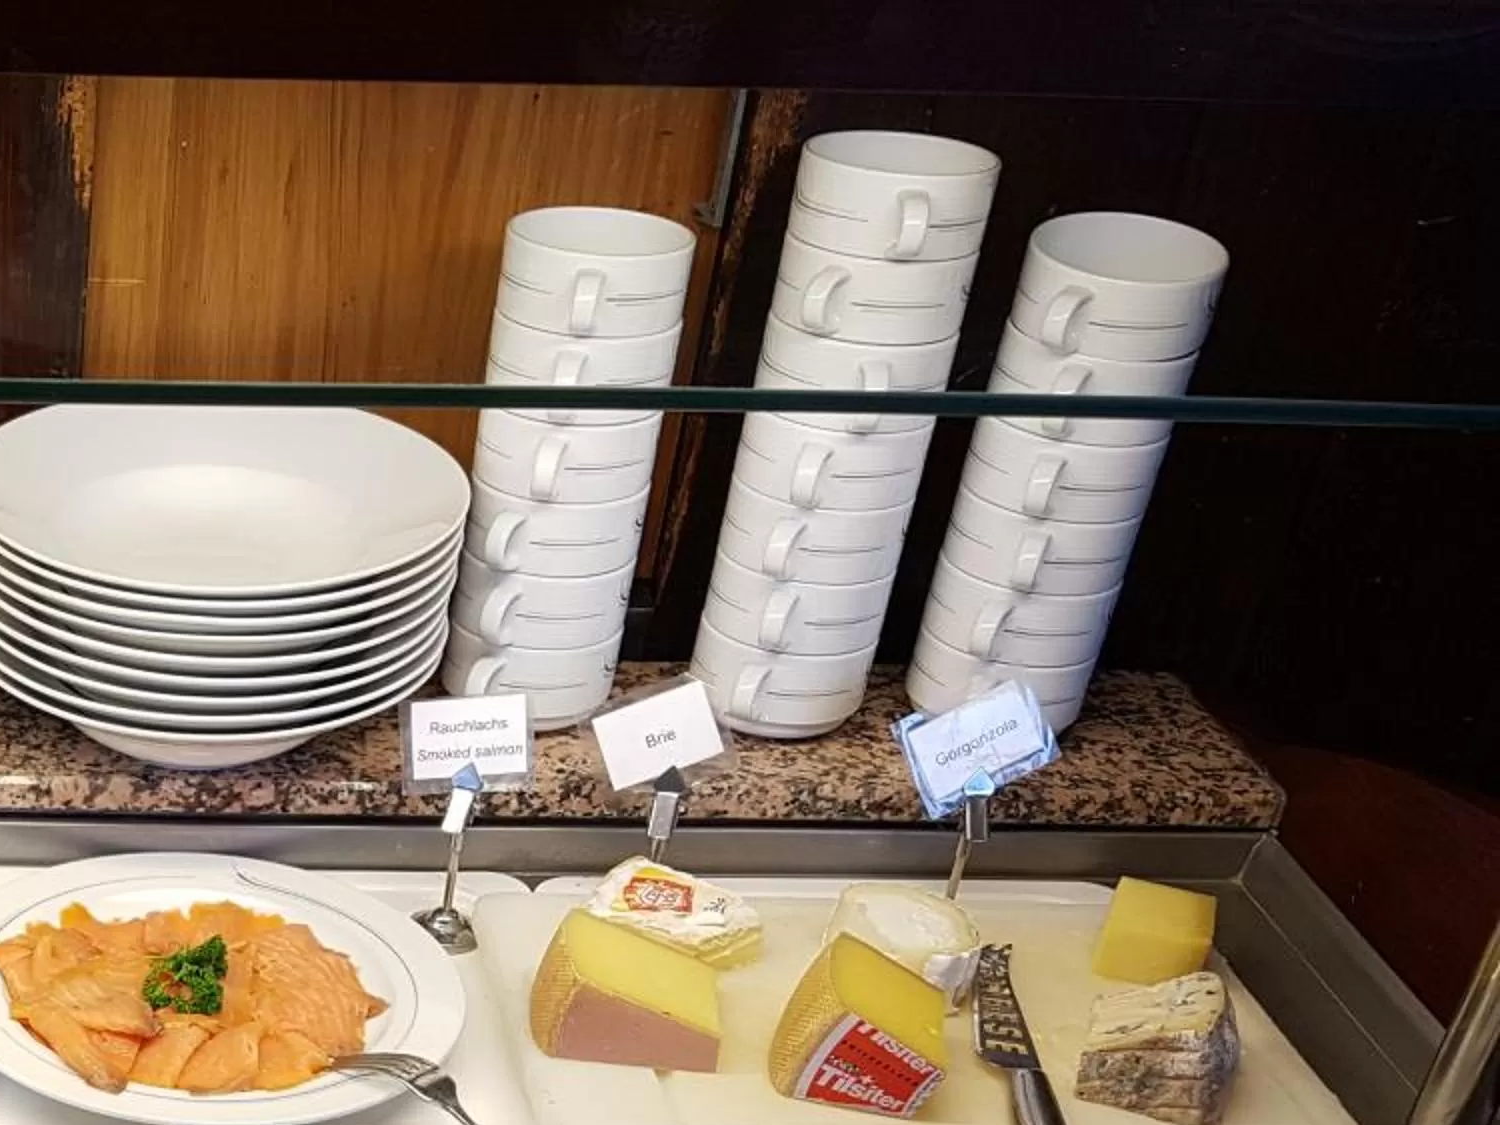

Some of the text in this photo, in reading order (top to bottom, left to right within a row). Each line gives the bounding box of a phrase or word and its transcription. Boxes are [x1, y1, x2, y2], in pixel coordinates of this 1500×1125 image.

[429, 718, 509, 735] Rauchlachs
[644, 729, 677, 749] Brie
[935, 718, 1018, 766] Gorgonzola
[417, 744, 523, 762] Smoked salmon
[815, 1063, 905, 1111] Tilsiter
